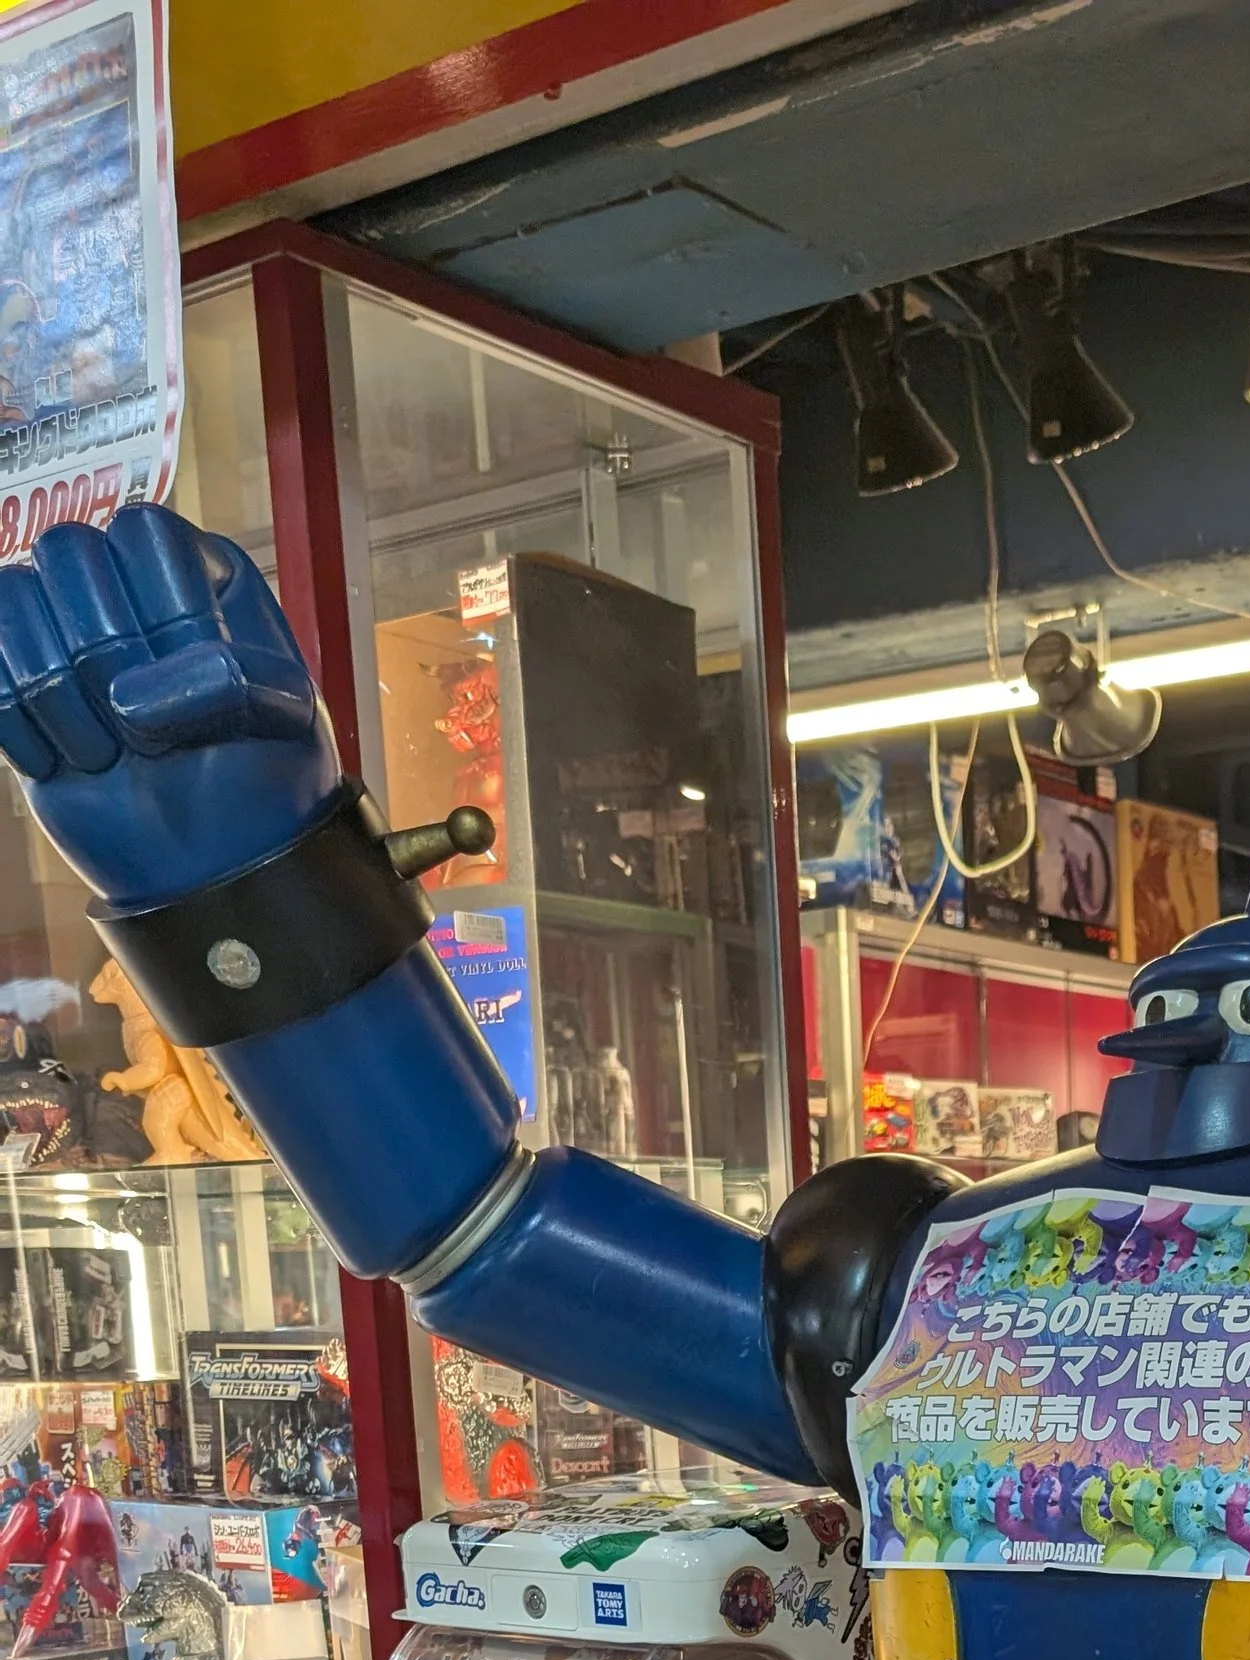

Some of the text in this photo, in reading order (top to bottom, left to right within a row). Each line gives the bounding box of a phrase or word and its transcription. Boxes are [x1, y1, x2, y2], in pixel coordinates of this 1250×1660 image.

[189, 1352, 321, 1392] TRANSFORMERS
[217, 1382, 291, 1398] TIMELINES
[1011, 1539, 1106, 1565] MANDARAKE
[595, 1590, 624, 1601] TAKARA
[595, 1599, 624, 1609] TOMY
